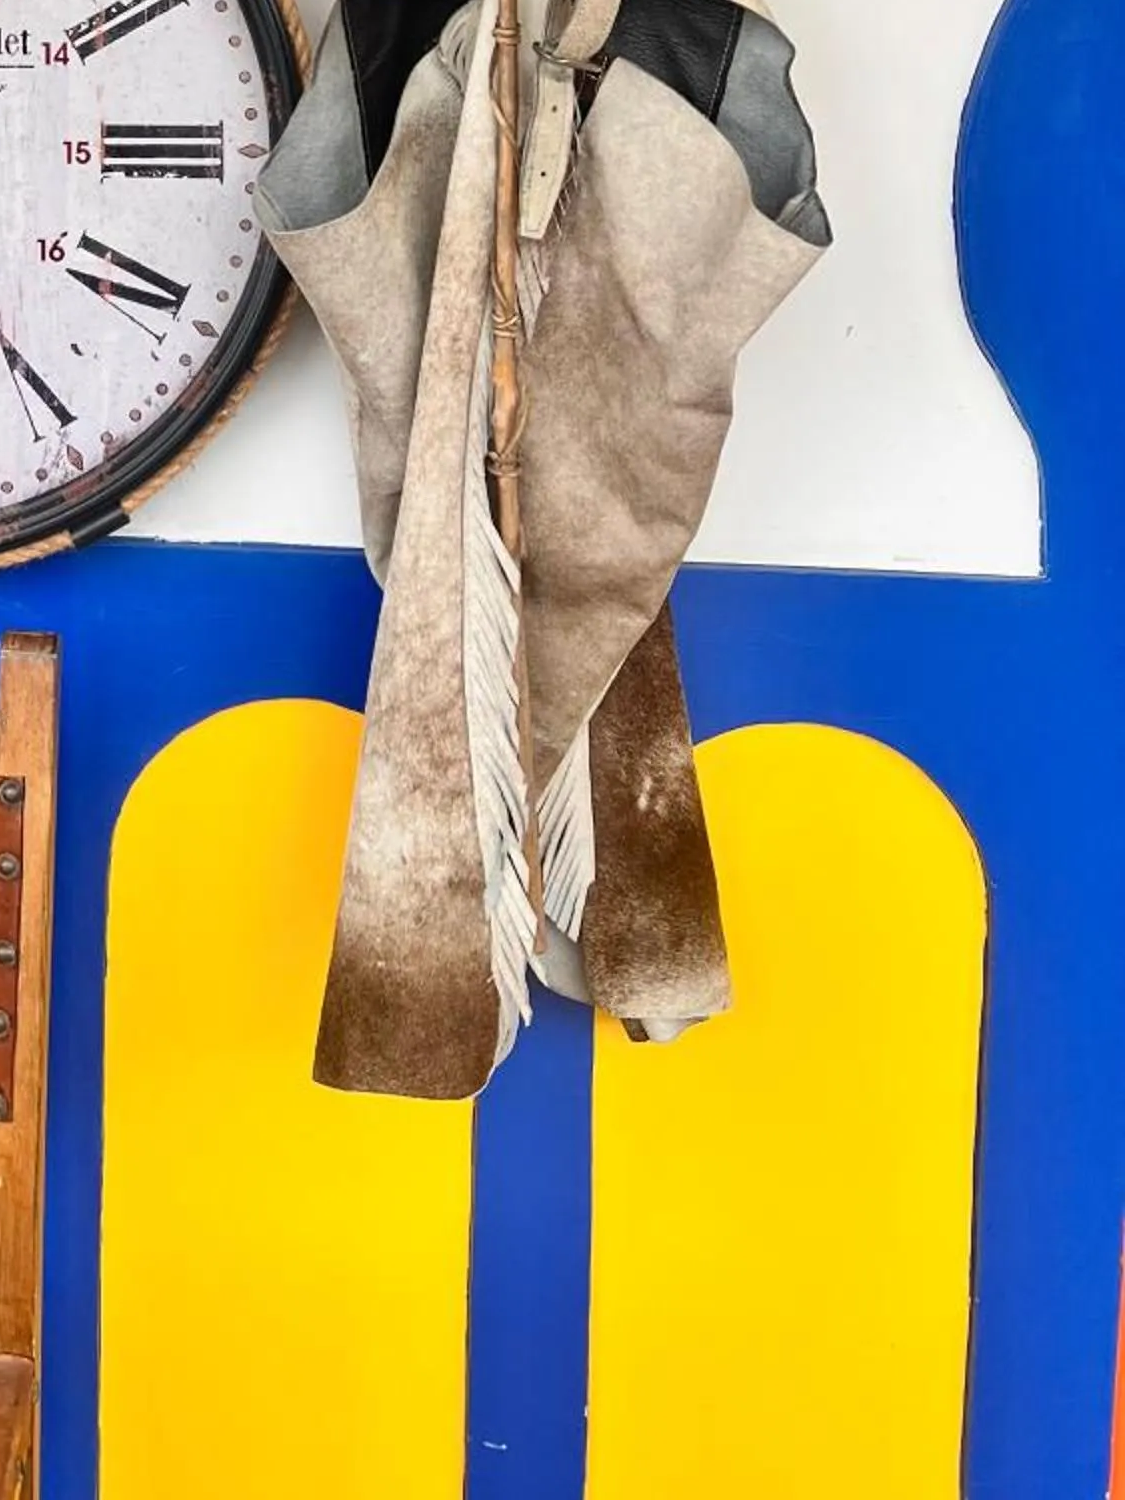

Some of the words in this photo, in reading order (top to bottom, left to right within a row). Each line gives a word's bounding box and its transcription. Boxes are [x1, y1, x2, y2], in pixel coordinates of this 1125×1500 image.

[42, 42, 70, 65] 14
[62, 141, 92, 165] 15
[101, 120, 223, 185] III
[37, 238, 66, 262] 16
